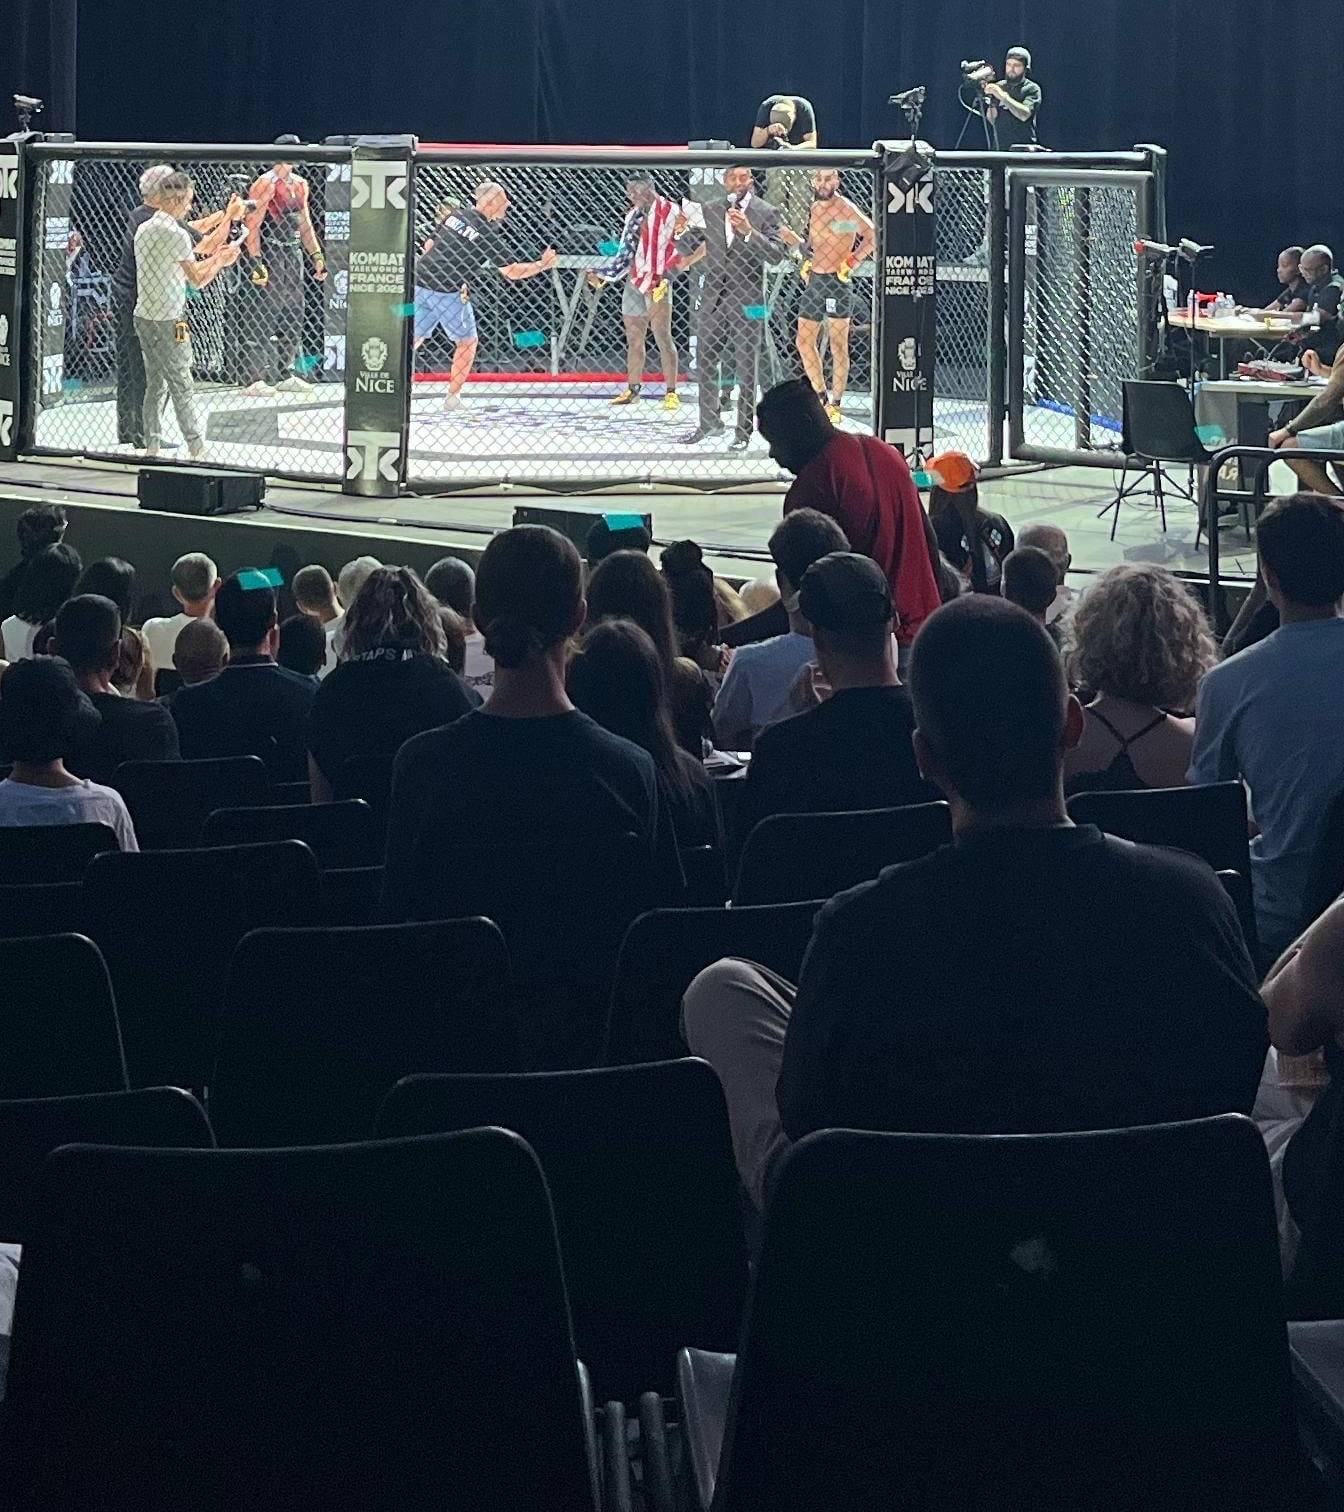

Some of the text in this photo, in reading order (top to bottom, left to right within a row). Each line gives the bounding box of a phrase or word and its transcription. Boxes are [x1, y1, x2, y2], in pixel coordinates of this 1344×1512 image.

[349, 252, 405, 266] KOMBAT
[349, 273, 405, 284] FRANCE
[349, 283, 405, 293] NICE 2025
[885, 286, 910, 295] NICE
[356, 378, 395, 394] NICE
[893, 377, 927, 392] NICE
